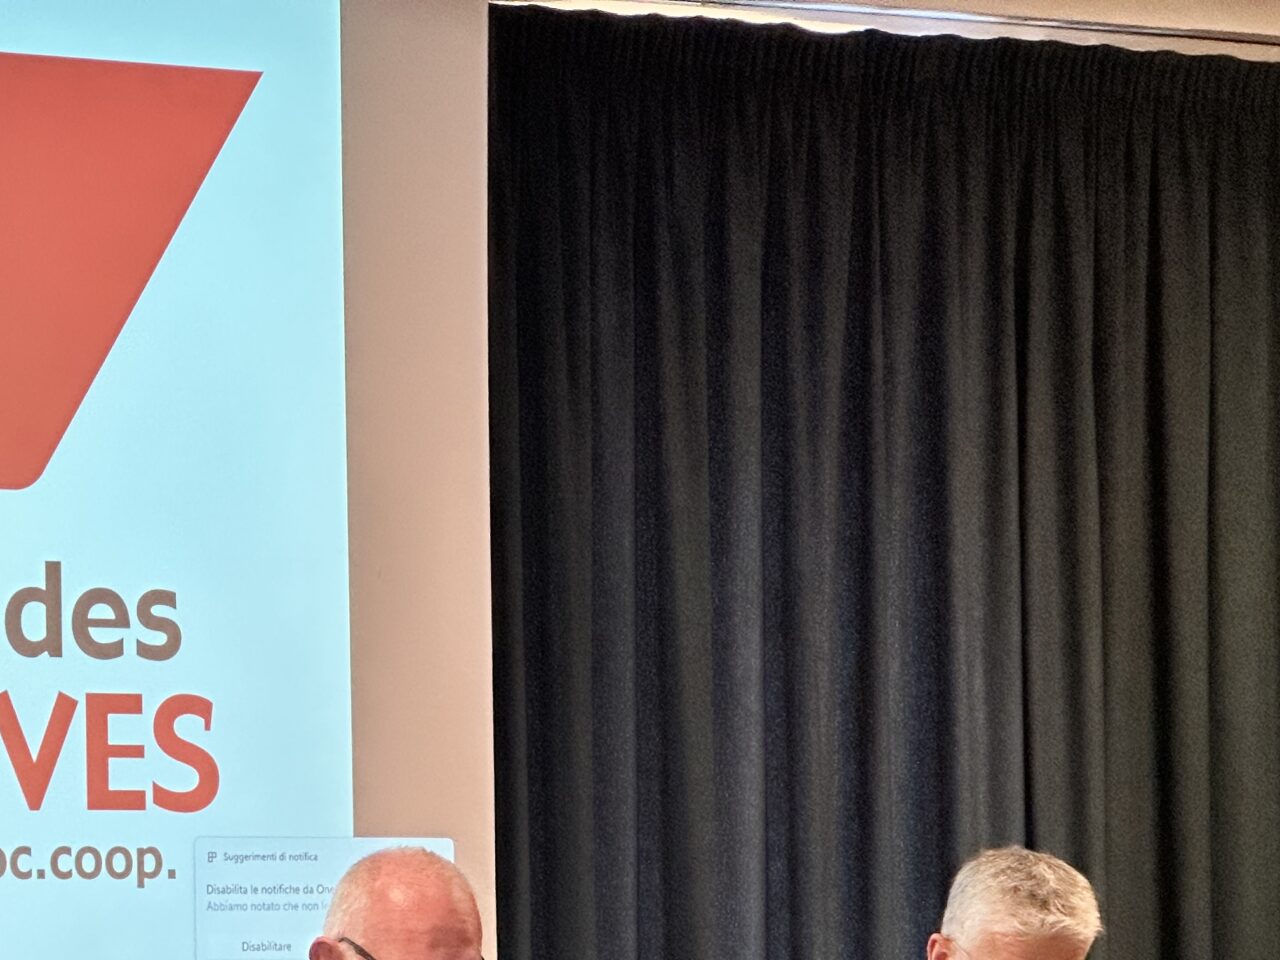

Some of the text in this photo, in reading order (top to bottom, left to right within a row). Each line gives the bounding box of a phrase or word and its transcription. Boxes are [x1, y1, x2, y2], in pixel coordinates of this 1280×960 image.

[5, 561, 182, 661] des
[223, 852, 318, 864] Suggerimenti di notifica
[206, 883, 248, 895] Disabilita
[251, 883, 259, 895] le
[261, 883, 300, 895] notifiche
[303, 884, 314, 894] da
[206, 901, 248, 911] Abbiamo
[251, 902, 280, 911] notato
[283, 901, 299, 911] che
[302, 903, 319, 911] non
[241, 940, 292, 951] Disabilitare
